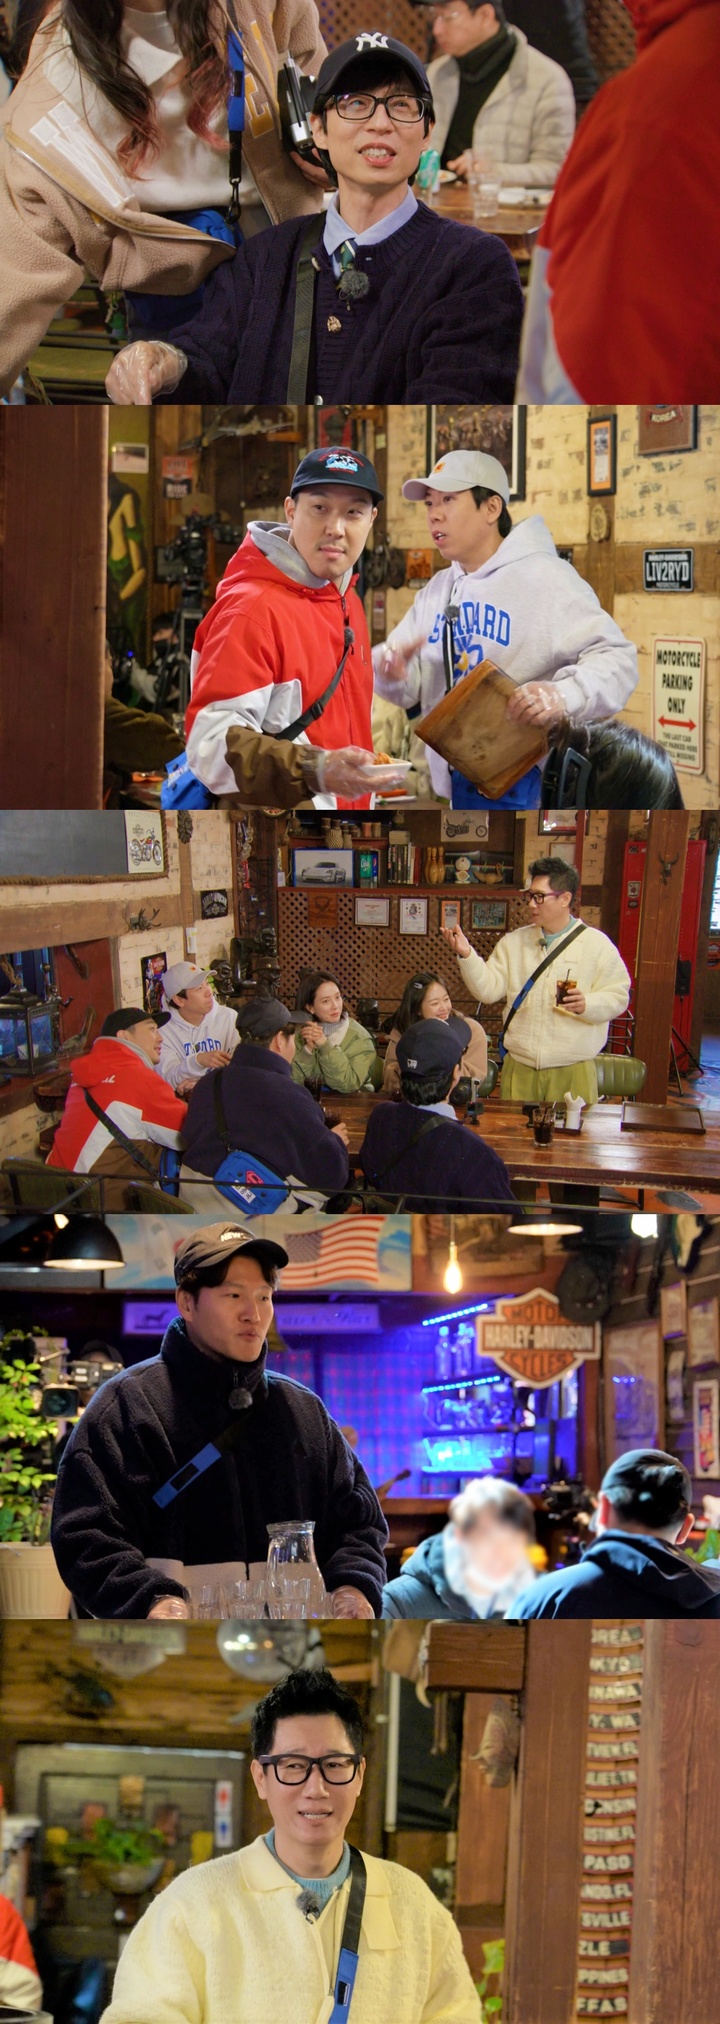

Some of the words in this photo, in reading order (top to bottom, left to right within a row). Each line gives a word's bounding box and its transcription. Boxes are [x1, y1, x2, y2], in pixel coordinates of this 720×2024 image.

[646, 562, 690, 581] LIV2RYD
[656, 650, 700, 668] MOTORCYCLE
[662, 673, 693, 691] PARKING
[667, 697, 686, 714] ONLY
[484, 1324, 594, 1350] HARLEY-DAVIDSON
[510, 1352, 567, 1380] CYCLES
[584, 1854, 631, 1870] PASO
